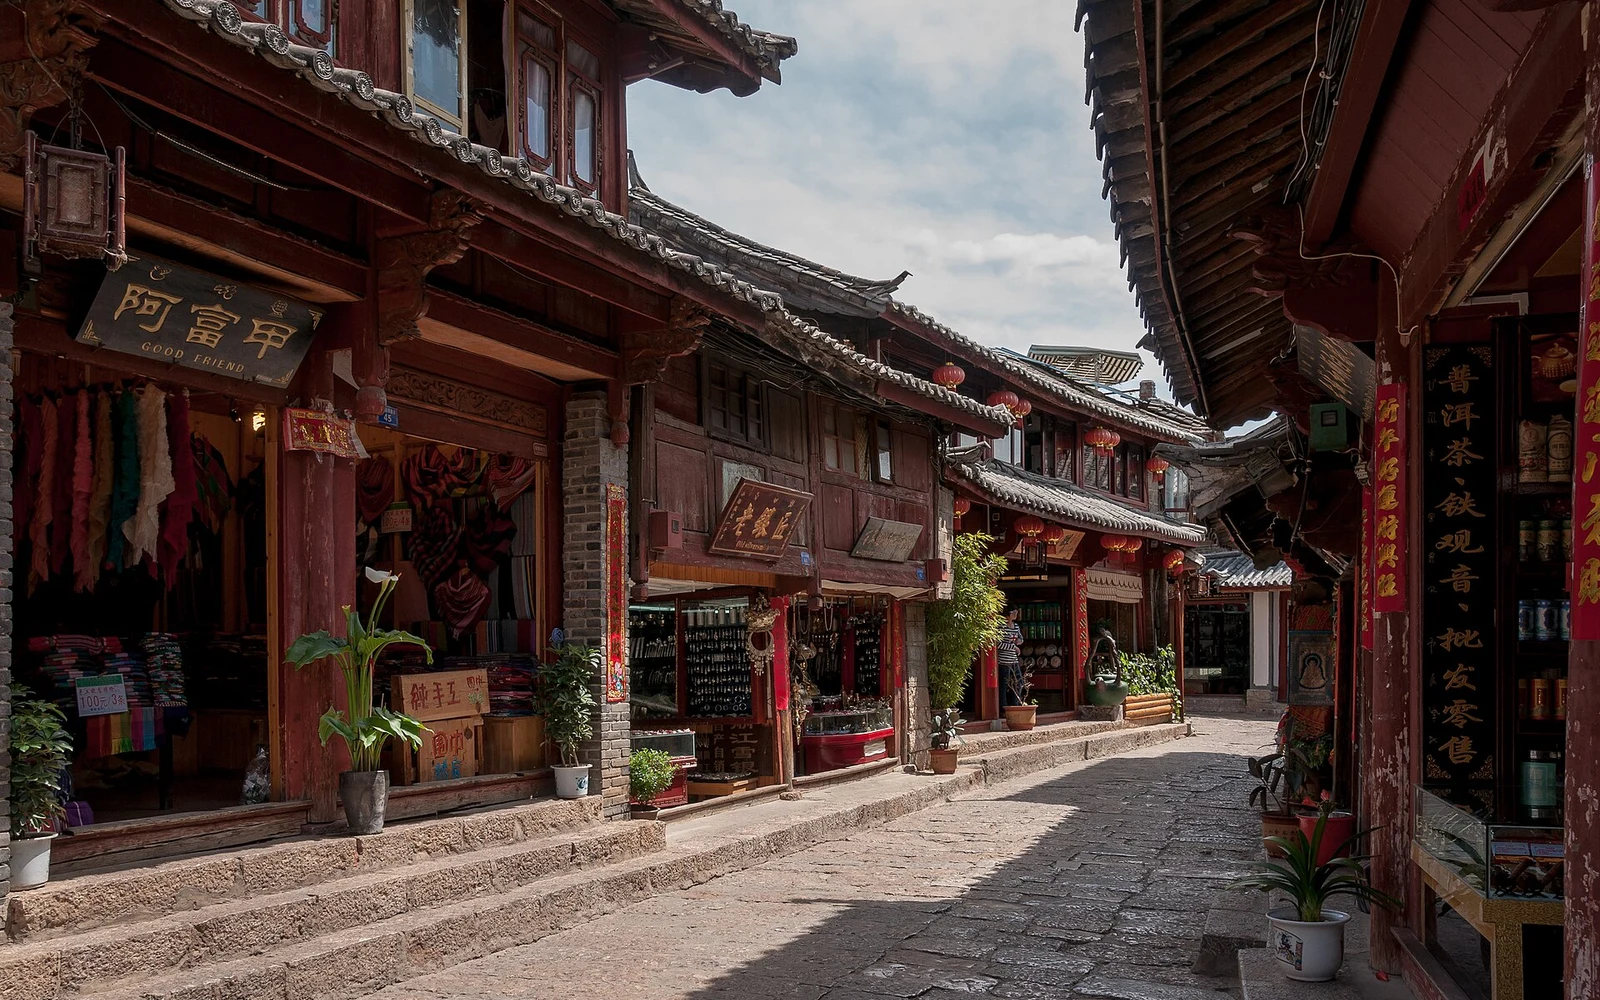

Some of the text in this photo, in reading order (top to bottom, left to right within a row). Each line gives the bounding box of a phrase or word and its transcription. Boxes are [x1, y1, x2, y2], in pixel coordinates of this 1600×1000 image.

[113, 283, 299, 359] 阿富甲
[141, 341, 246, 374] GOOD FRIEND
[383, 413, 393, 423] 45
